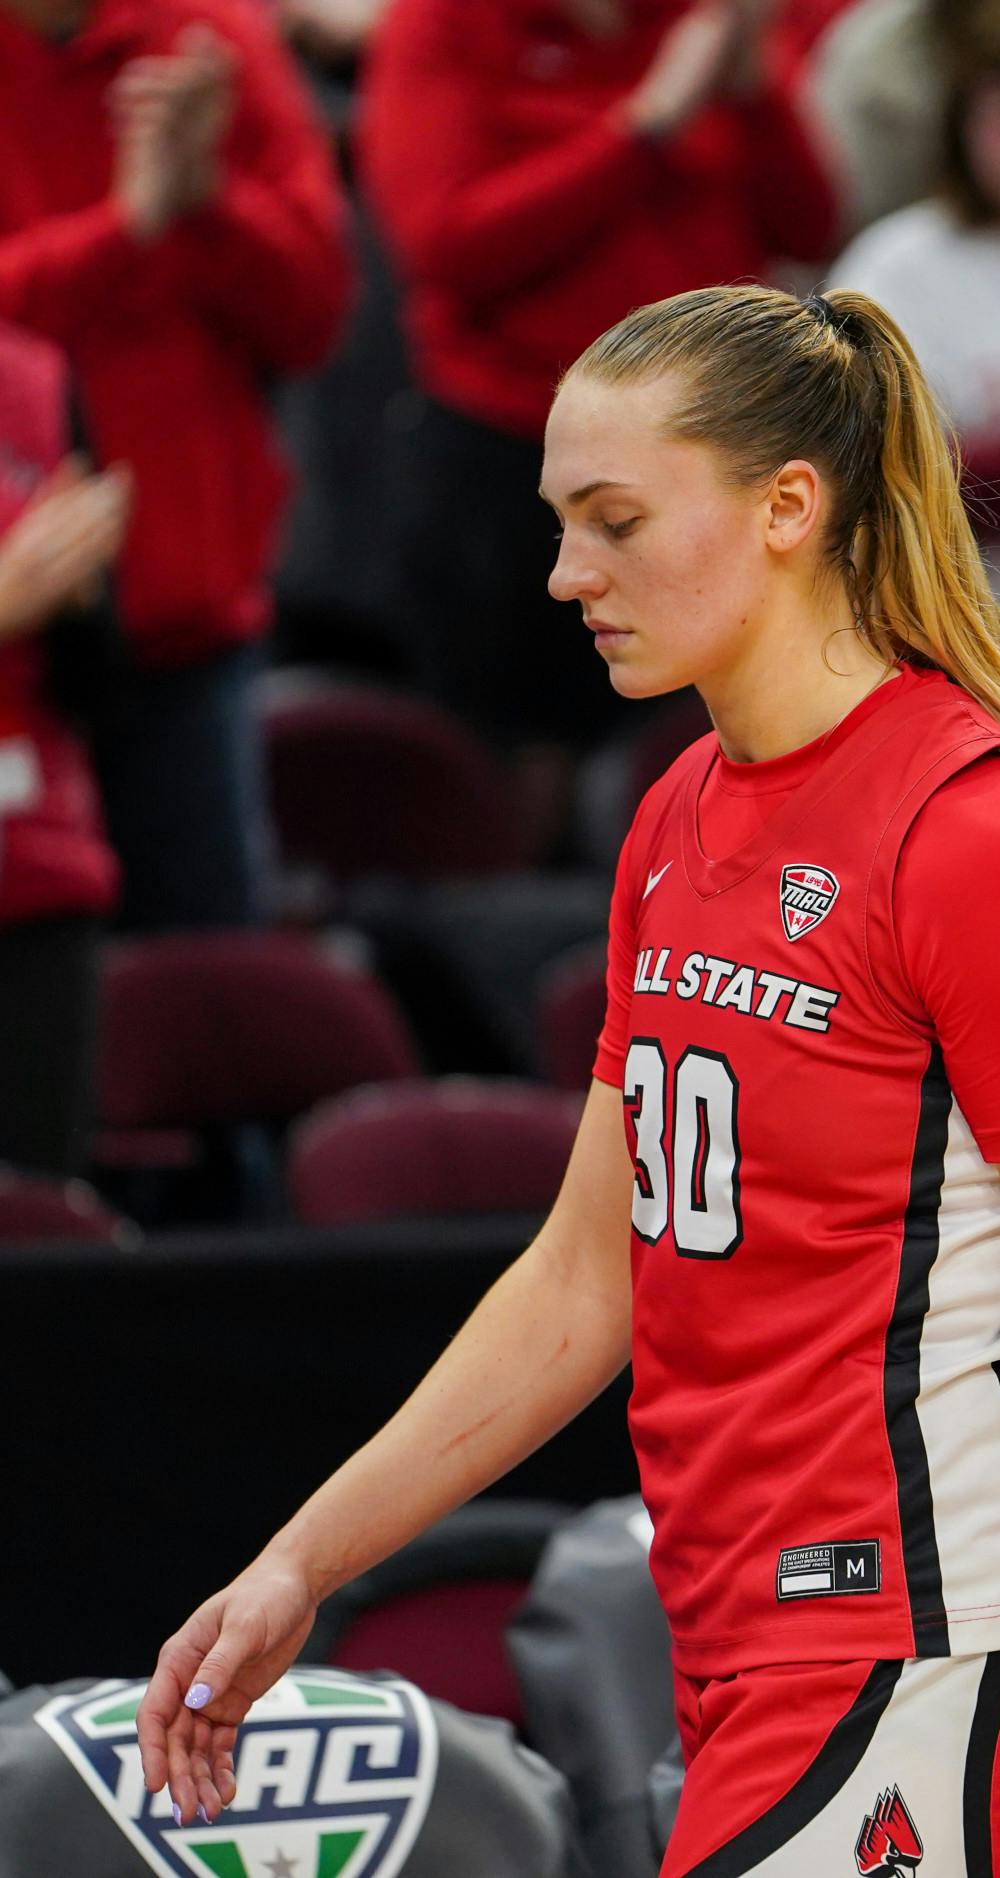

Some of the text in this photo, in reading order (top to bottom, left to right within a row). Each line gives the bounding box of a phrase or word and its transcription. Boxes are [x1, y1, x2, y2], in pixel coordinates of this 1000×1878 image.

[781, 883, 830, 914] MAC
[675, 951, 841, 1035] STATE
[622, 1035, 744, 1261] 30
[782, 1549, 831, 1563] ENGINEERED
[846, 1557, 865, 1579] M
